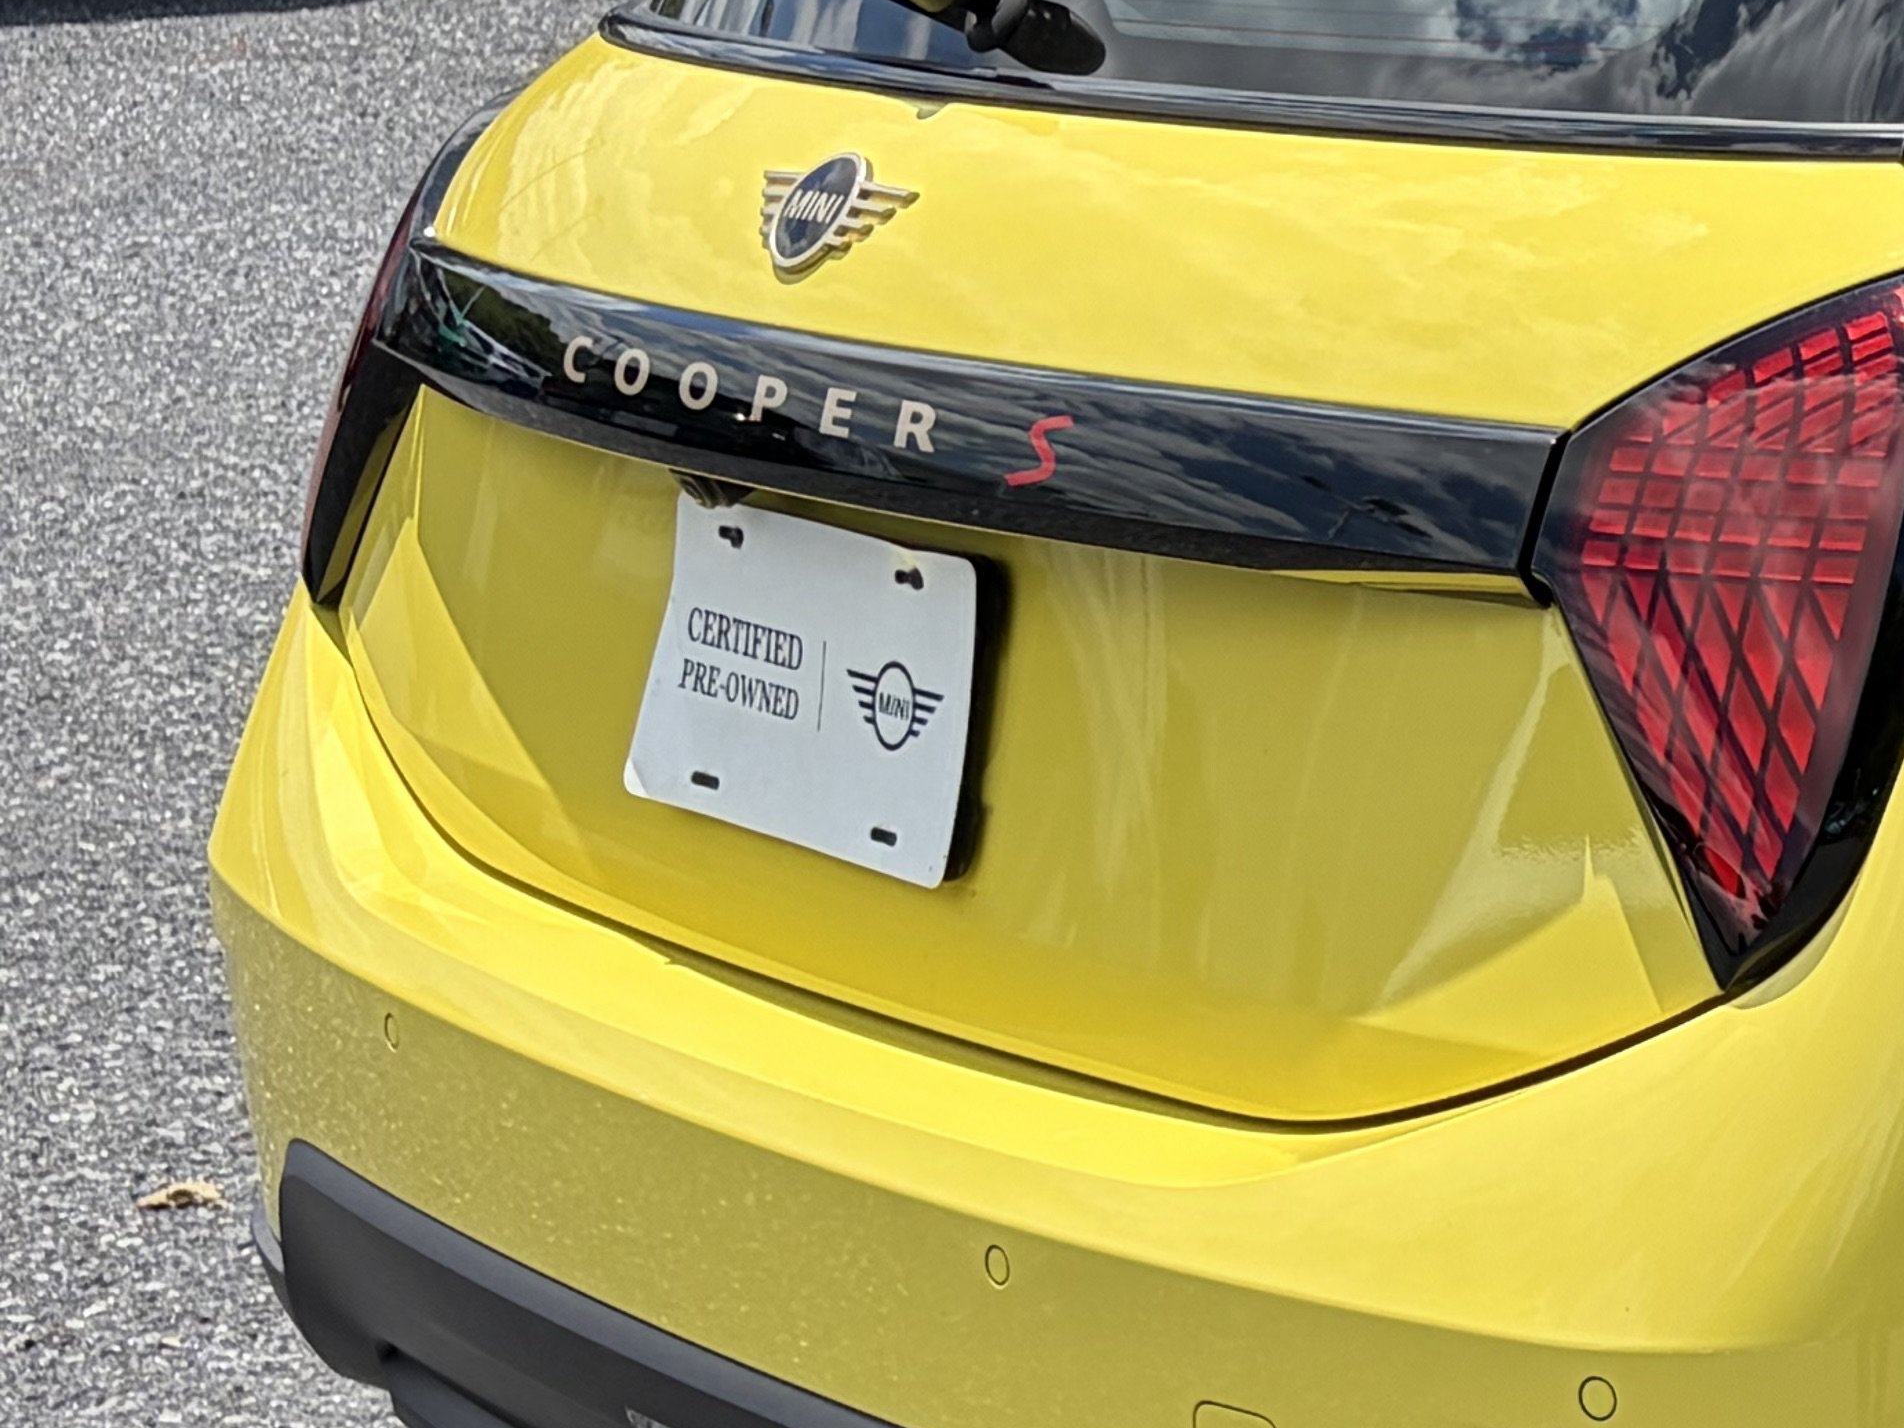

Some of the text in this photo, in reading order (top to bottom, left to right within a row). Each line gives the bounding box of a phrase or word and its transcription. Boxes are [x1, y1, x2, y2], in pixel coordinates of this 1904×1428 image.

[783, 187, 846, 224] MINI
[561, 335, 1075, 487] COOPER S
[687, 606, 804, 671] CERTIFIED
[677, 657, 800, 721] PRE-OWNED
[878, 692, 911, 721] MINI
